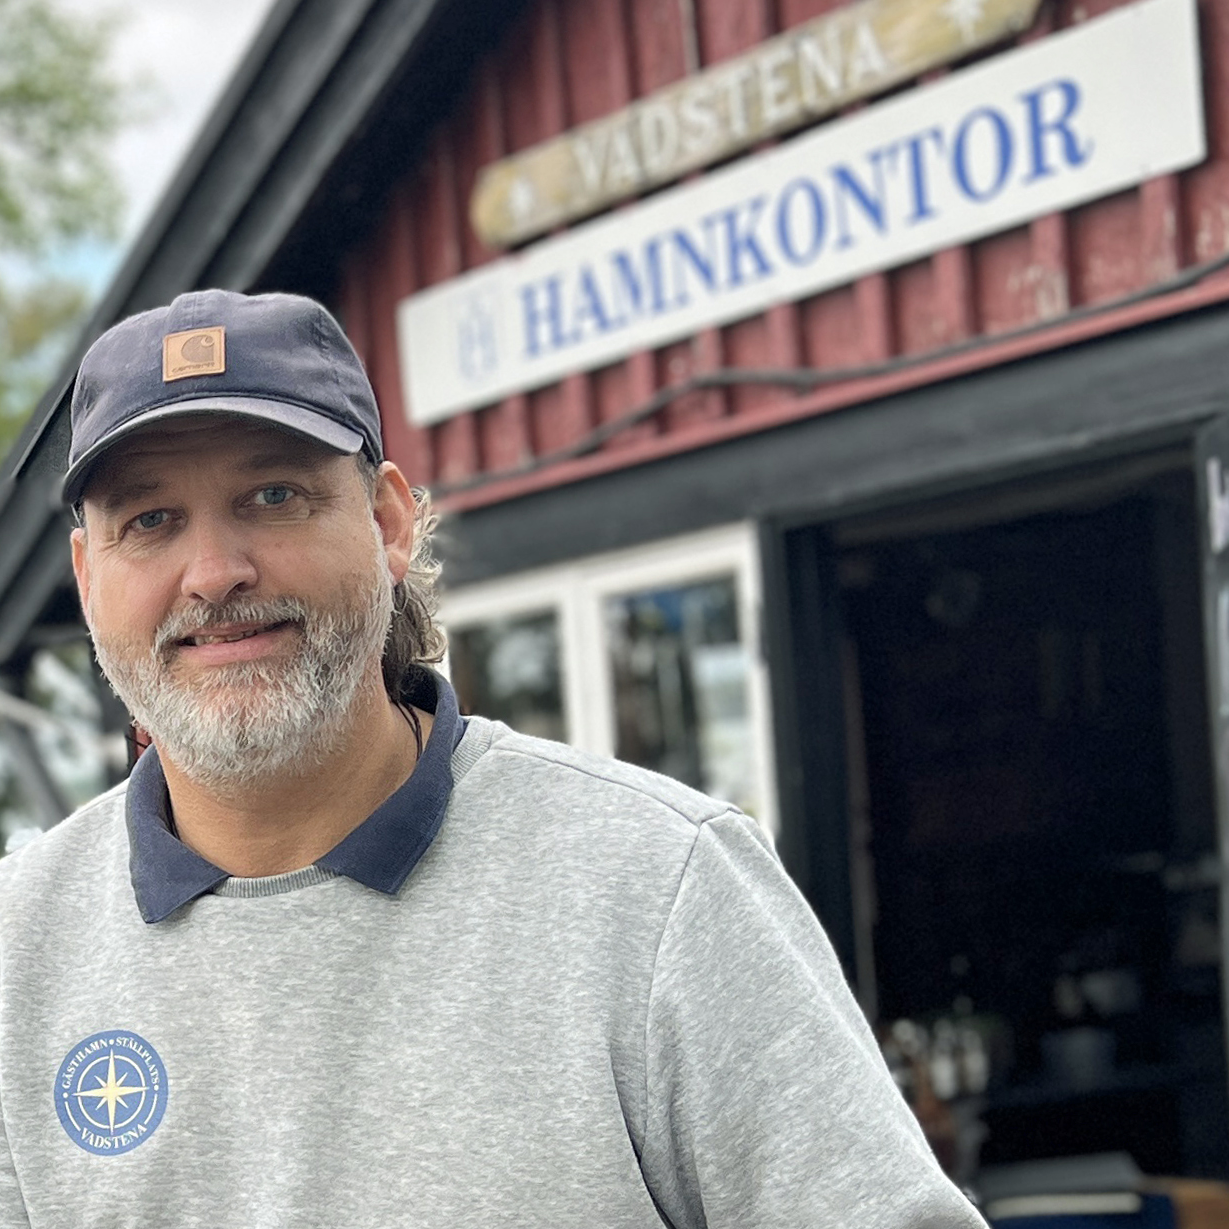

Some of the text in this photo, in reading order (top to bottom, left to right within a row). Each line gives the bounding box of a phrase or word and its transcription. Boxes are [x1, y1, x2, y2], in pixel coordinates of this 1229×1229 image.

[572, 26, 890, 191] VADSTENA
[518, 78, 1094, 359] HAMNKONTOR
[62, 1037, 109, 1089] GÄSTHAMN
[80, 1123, 148, 1149] VADSTENA
